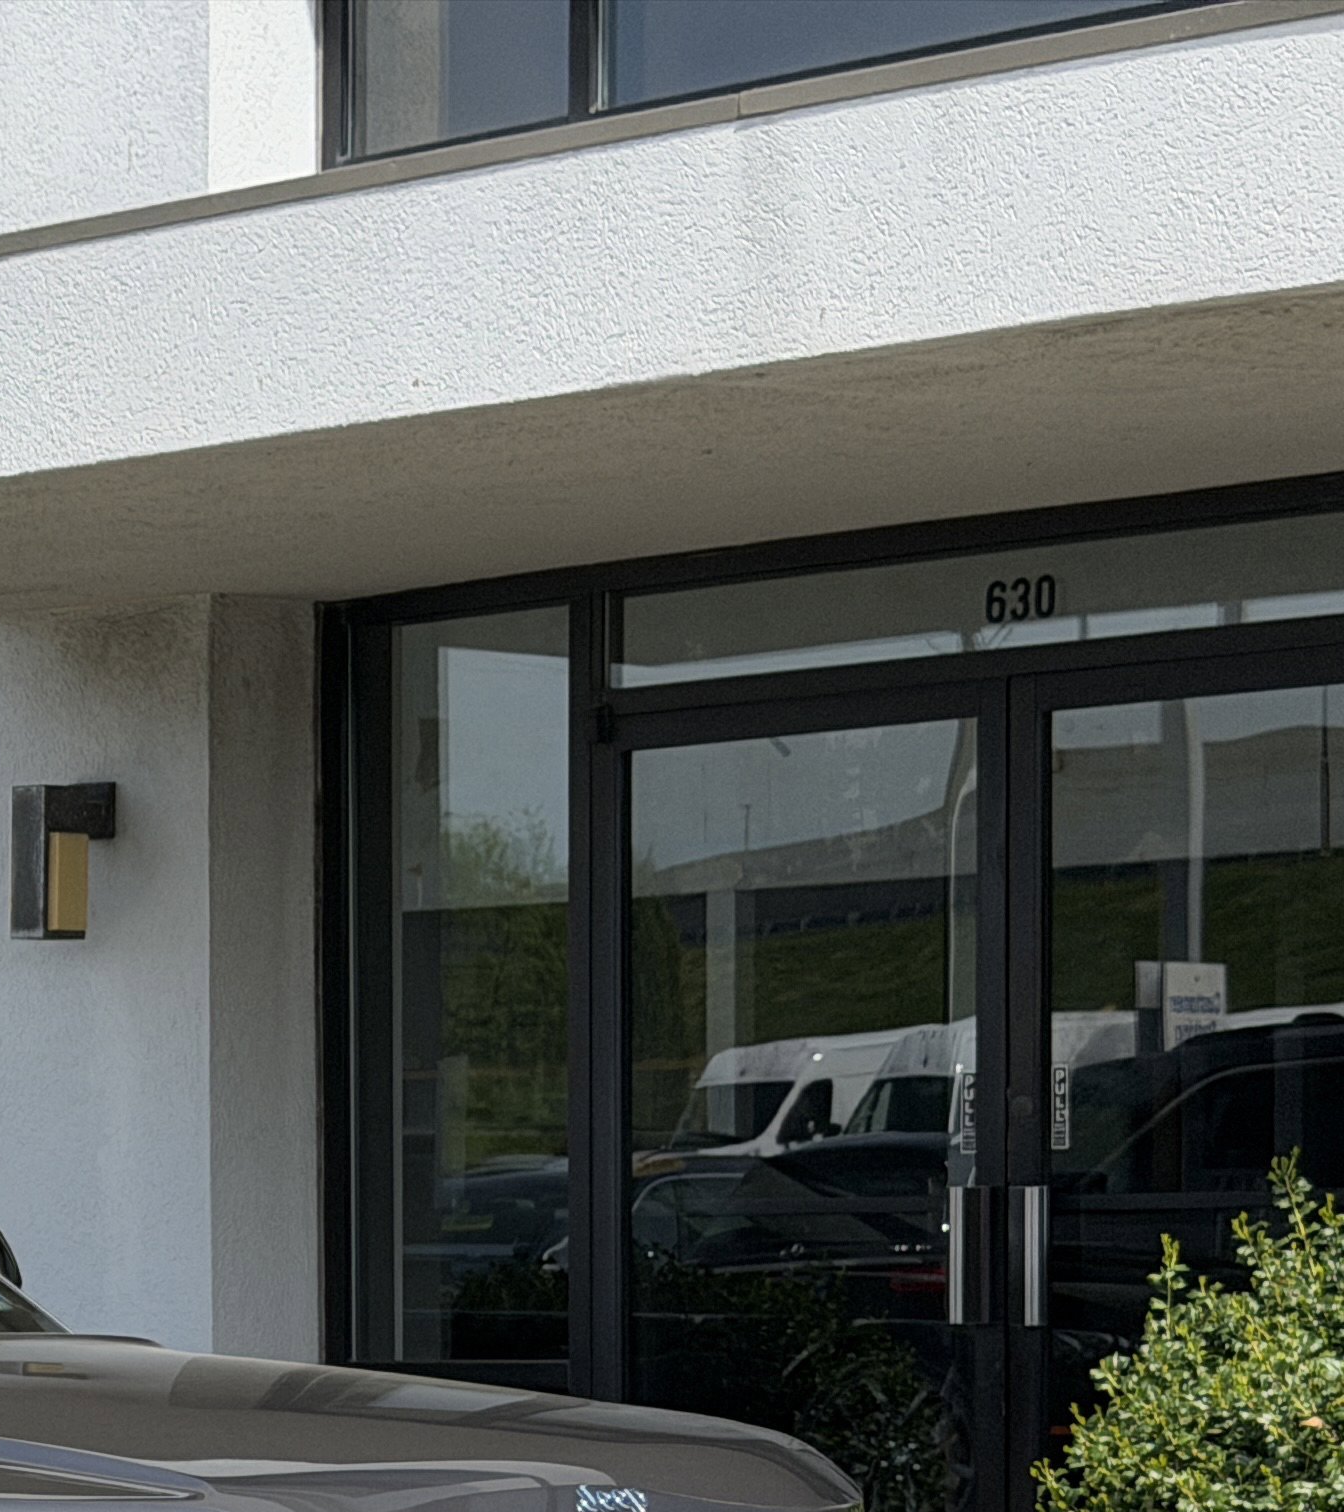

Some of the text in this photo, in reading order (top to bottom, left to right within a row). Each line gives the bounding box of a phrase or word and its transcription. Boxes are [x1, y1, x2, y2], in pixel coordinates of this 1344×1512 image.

[985, 574, 1056, 623] 630
[964, 1074, 975, 1127] PULL
[1055, 1069, 1065, 1122] PULL
